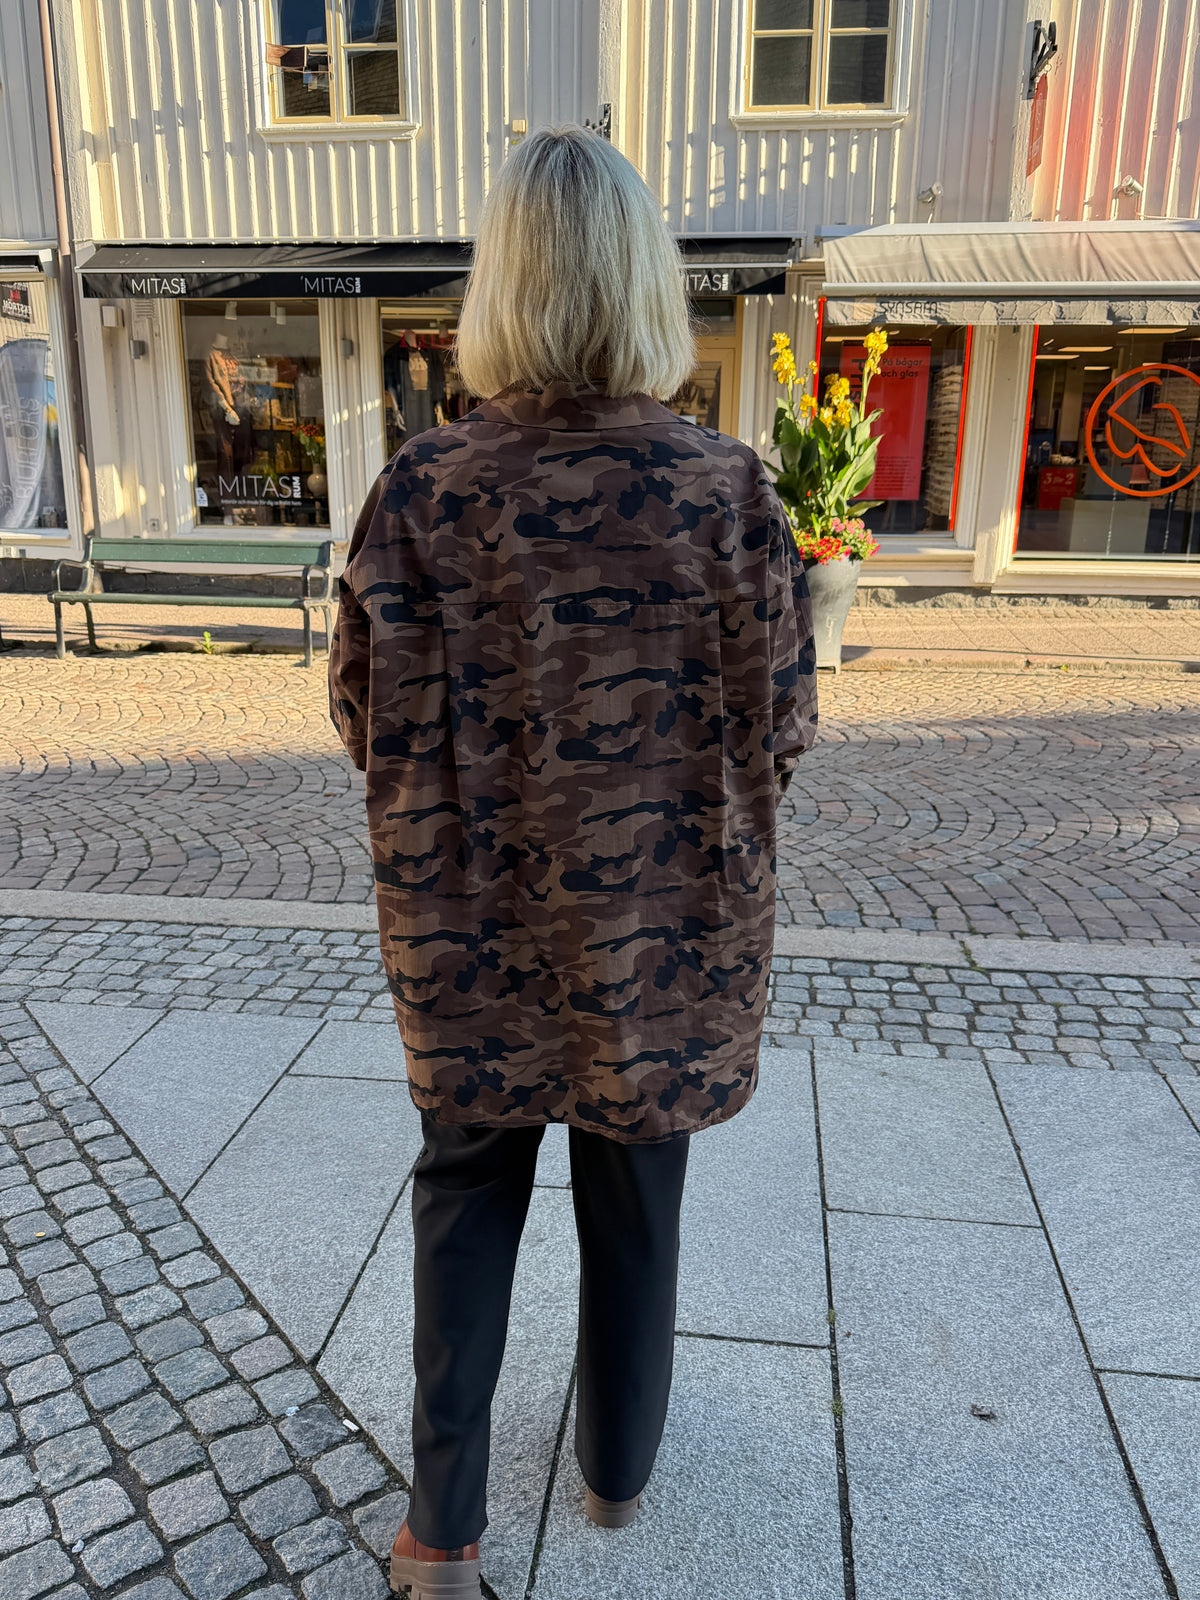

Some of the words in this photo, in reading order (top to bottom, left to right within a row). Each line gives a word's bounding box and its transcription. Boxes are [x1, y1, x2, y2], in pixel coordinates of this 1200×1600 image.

[131, 278, 180, 294] MITAS
[303, 277, 355, 293] MITAS
[686, 273, 722, 291] ITAS
[895, 357, 923, 368] bågar
[881, 369, 898, 378] och
[899, 369, 919, 379] glas
[1064, 472, 1074, 485] 2
[218, 475, 292, 499] MITAS
[292, 475, 302, 499] RUM
